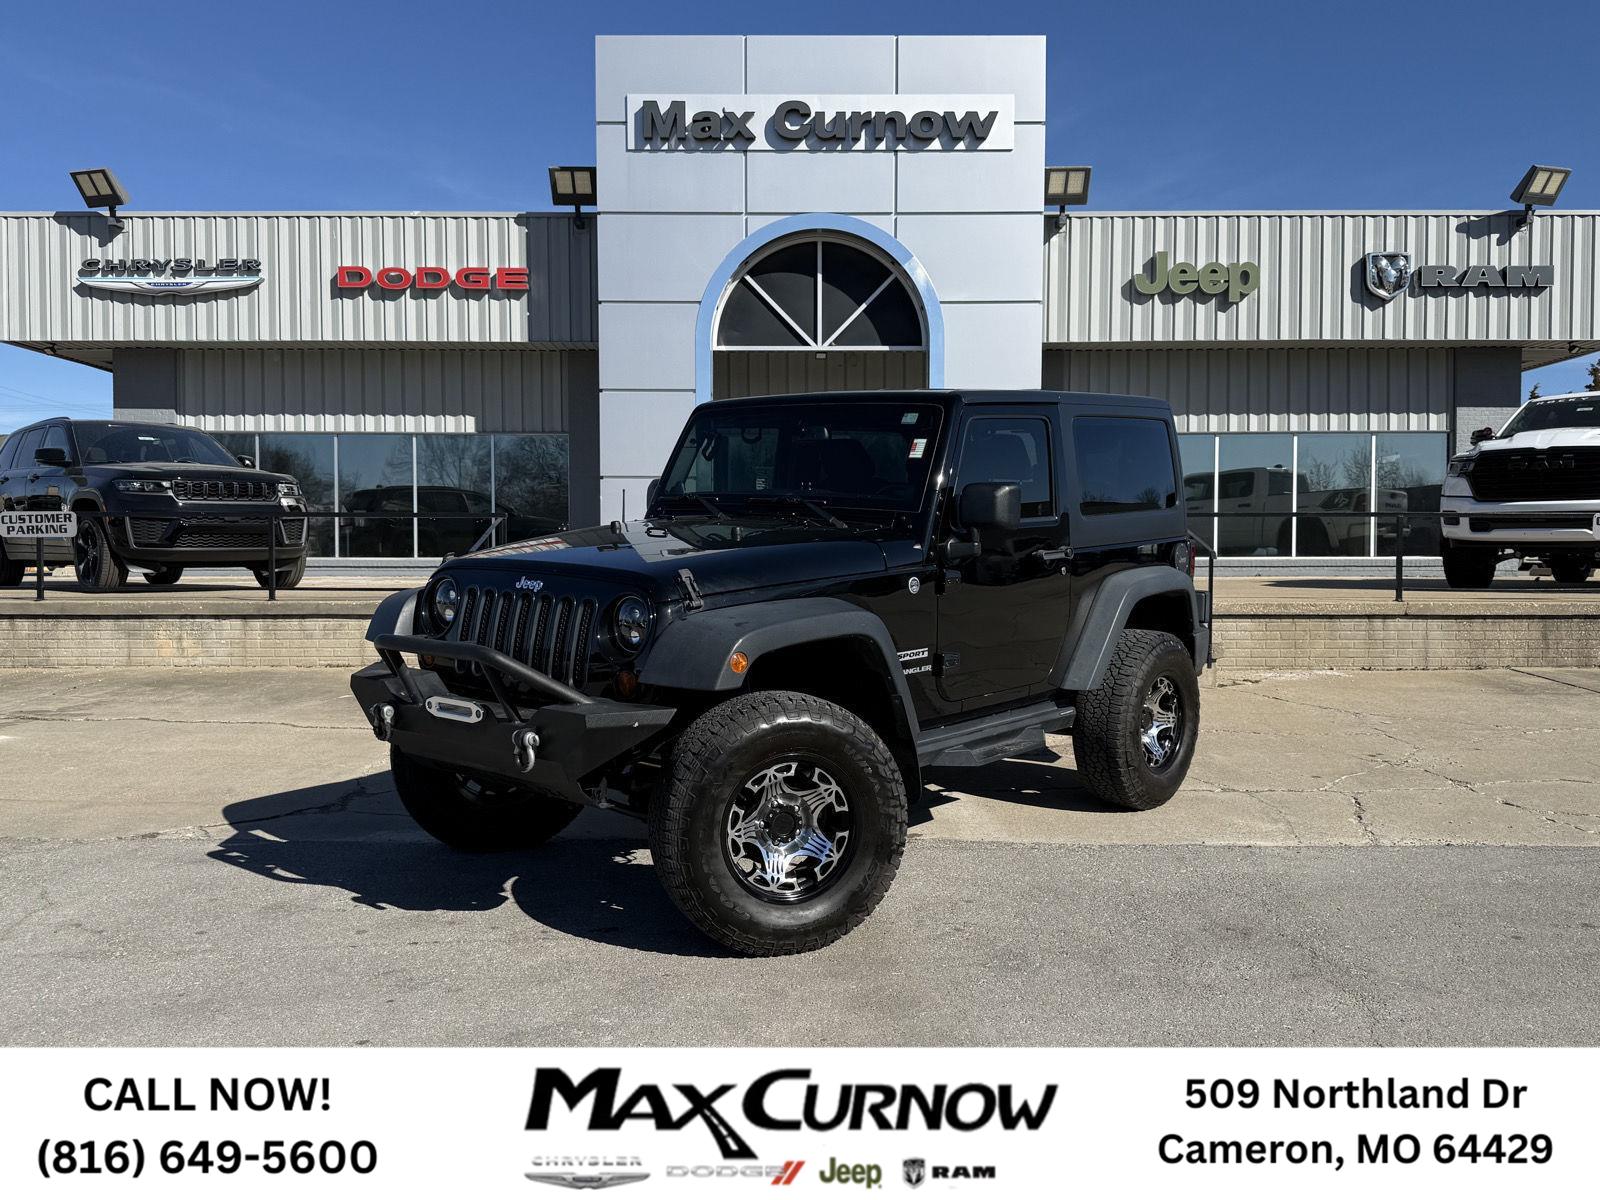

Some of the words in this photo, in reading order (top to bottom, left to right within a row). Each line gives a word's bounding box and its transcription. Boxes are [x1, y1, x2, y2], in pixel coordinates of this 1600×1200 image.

[642, 100, 756, 141] Max
[773, 100, 998, 141] Curnow
[81, 258, 262, 271] CHRYSLER
[337, 266, 529, 290] DODGE
[1134, 251, 1261, 302] Jeep
[1421, 265, 1555, 287] RAM
[1, 513, 73, 524] CUSTOMER
[6, 524, 68, 535] PARKING
[515, 575, 543, 592] Jeep
[898, 650, 926, 659] SPORT
